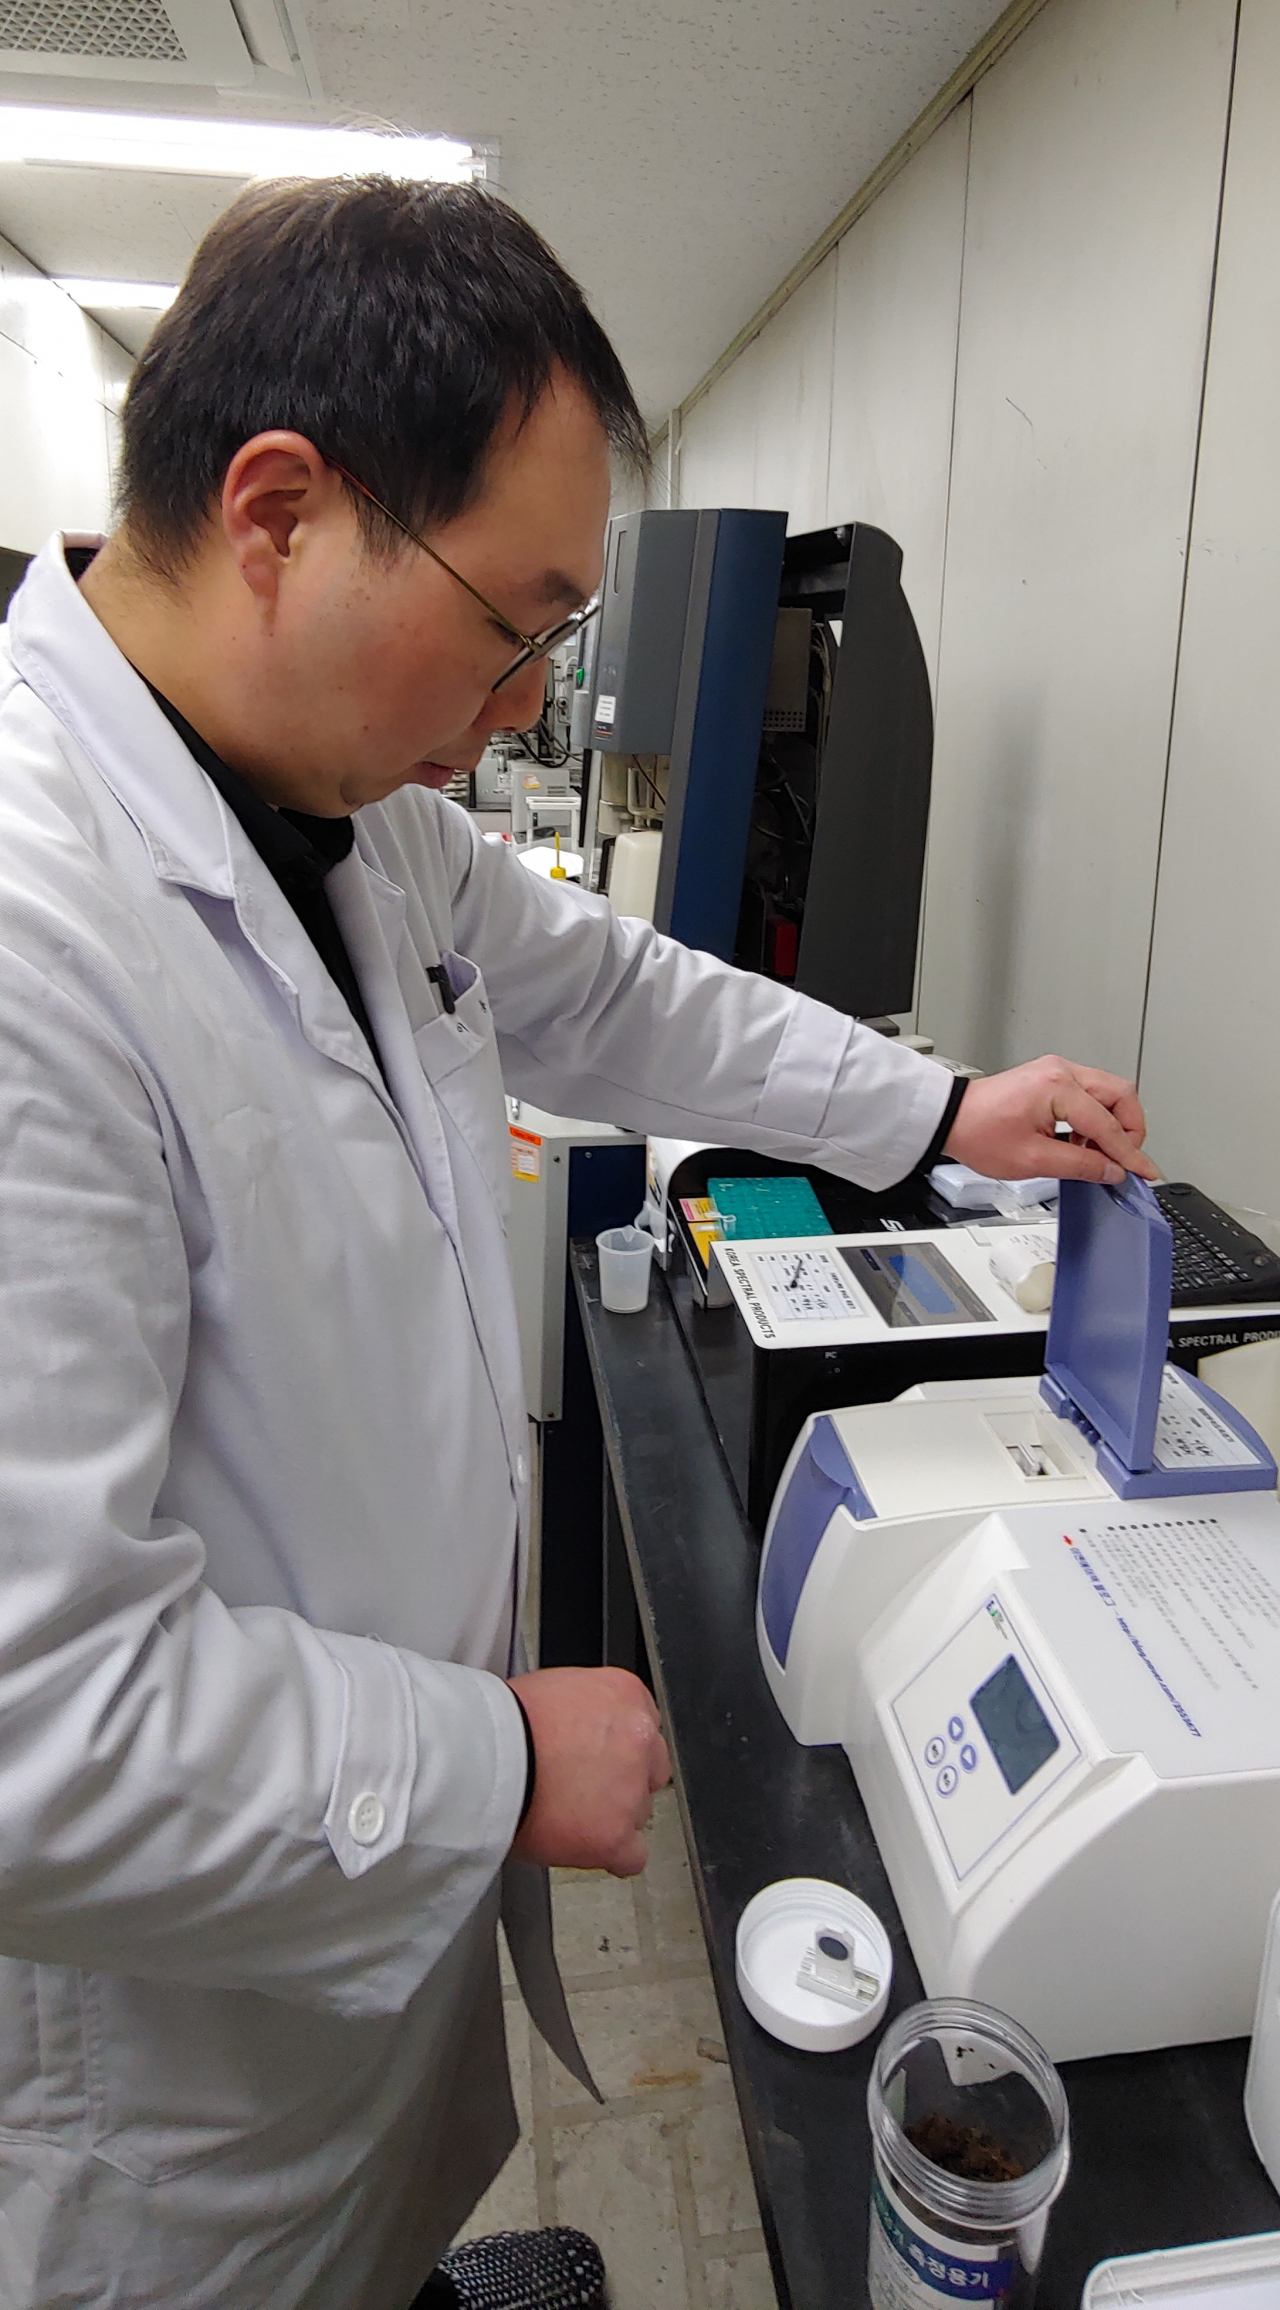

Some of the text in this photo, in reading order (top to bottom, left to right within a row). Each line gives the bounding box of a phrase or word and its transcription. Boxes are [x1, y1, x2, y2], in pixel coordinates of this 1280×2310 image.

[723, 1247, 776, 1339] KOREA SPECTRAL PRODUCTS
[824, 1351, 838, 1359] PC
[1177, 1333, 1240, 1348] SPECTRAL
[907, 2243, 989, 2288] 측정용기
